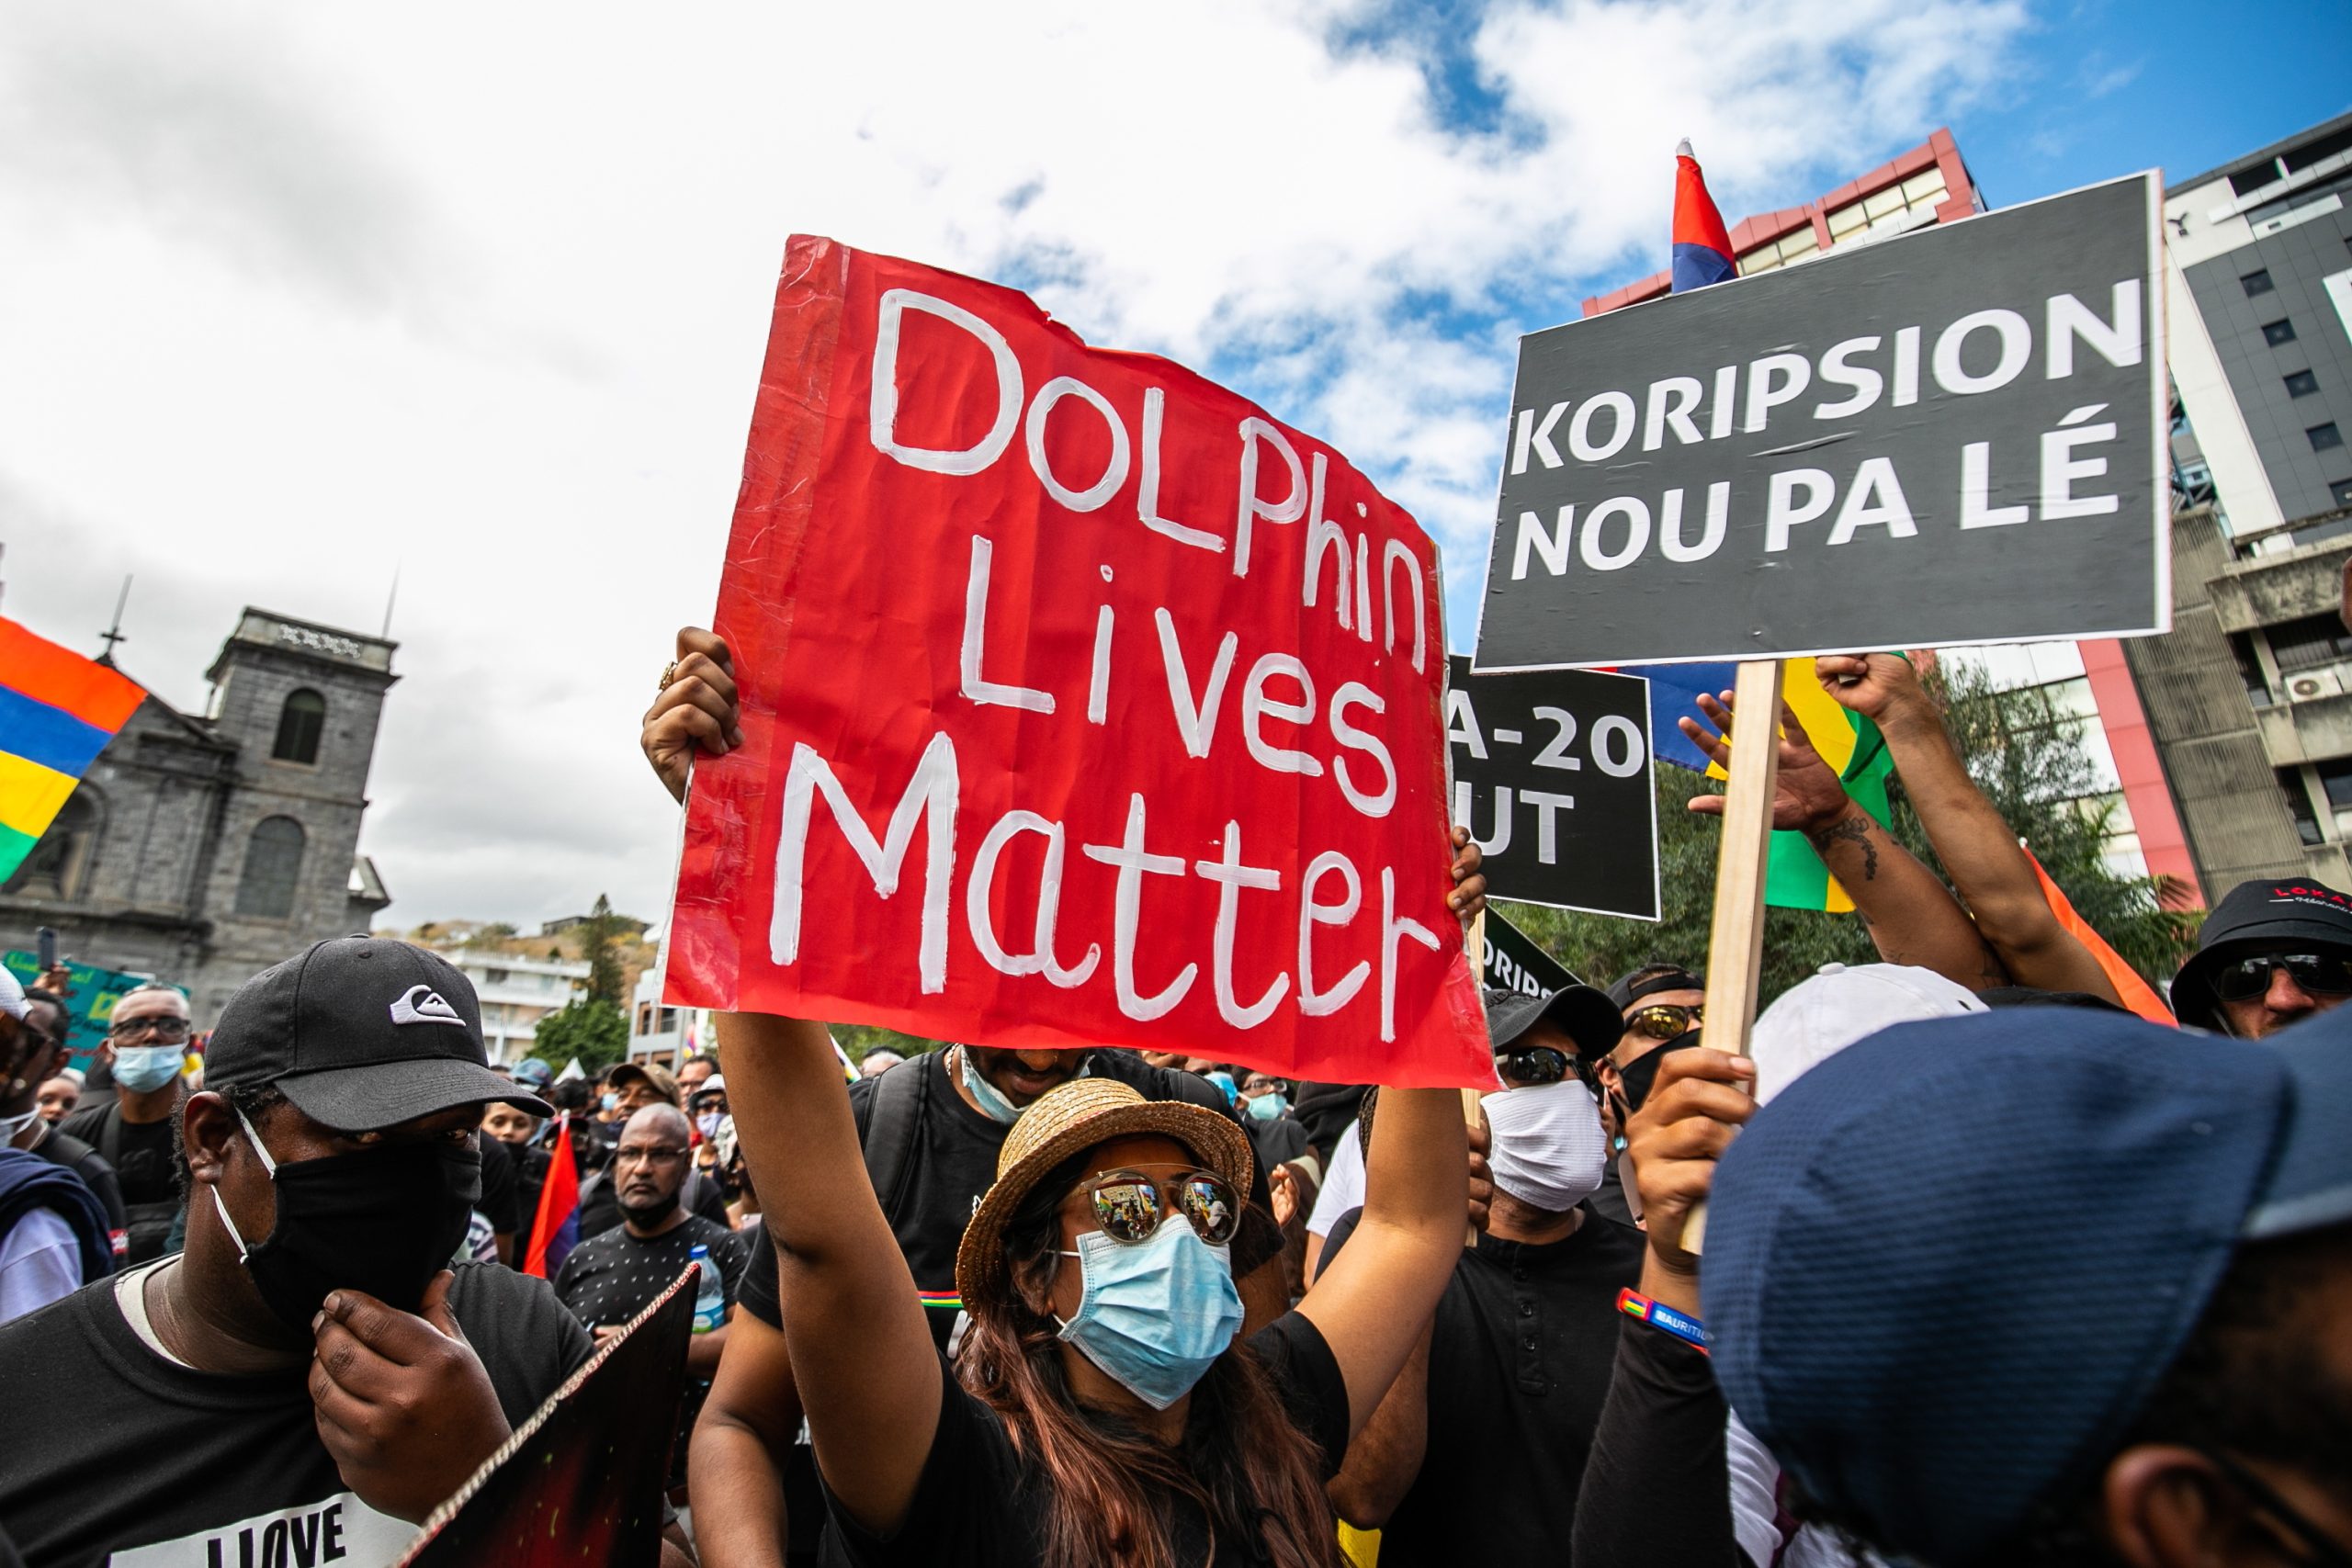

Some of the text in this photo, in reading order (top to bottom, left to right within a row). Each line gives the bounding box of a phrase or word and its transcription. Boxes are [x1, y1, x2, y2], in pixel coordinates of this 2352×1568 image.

[1511, 278, 2142, 476] KORIPSION
[1511, 403, 2119, 581] NOU PA LÉ
[770, 731, 1441, 1043] Matter
[2274, 886, 2352, 909] LOKA
